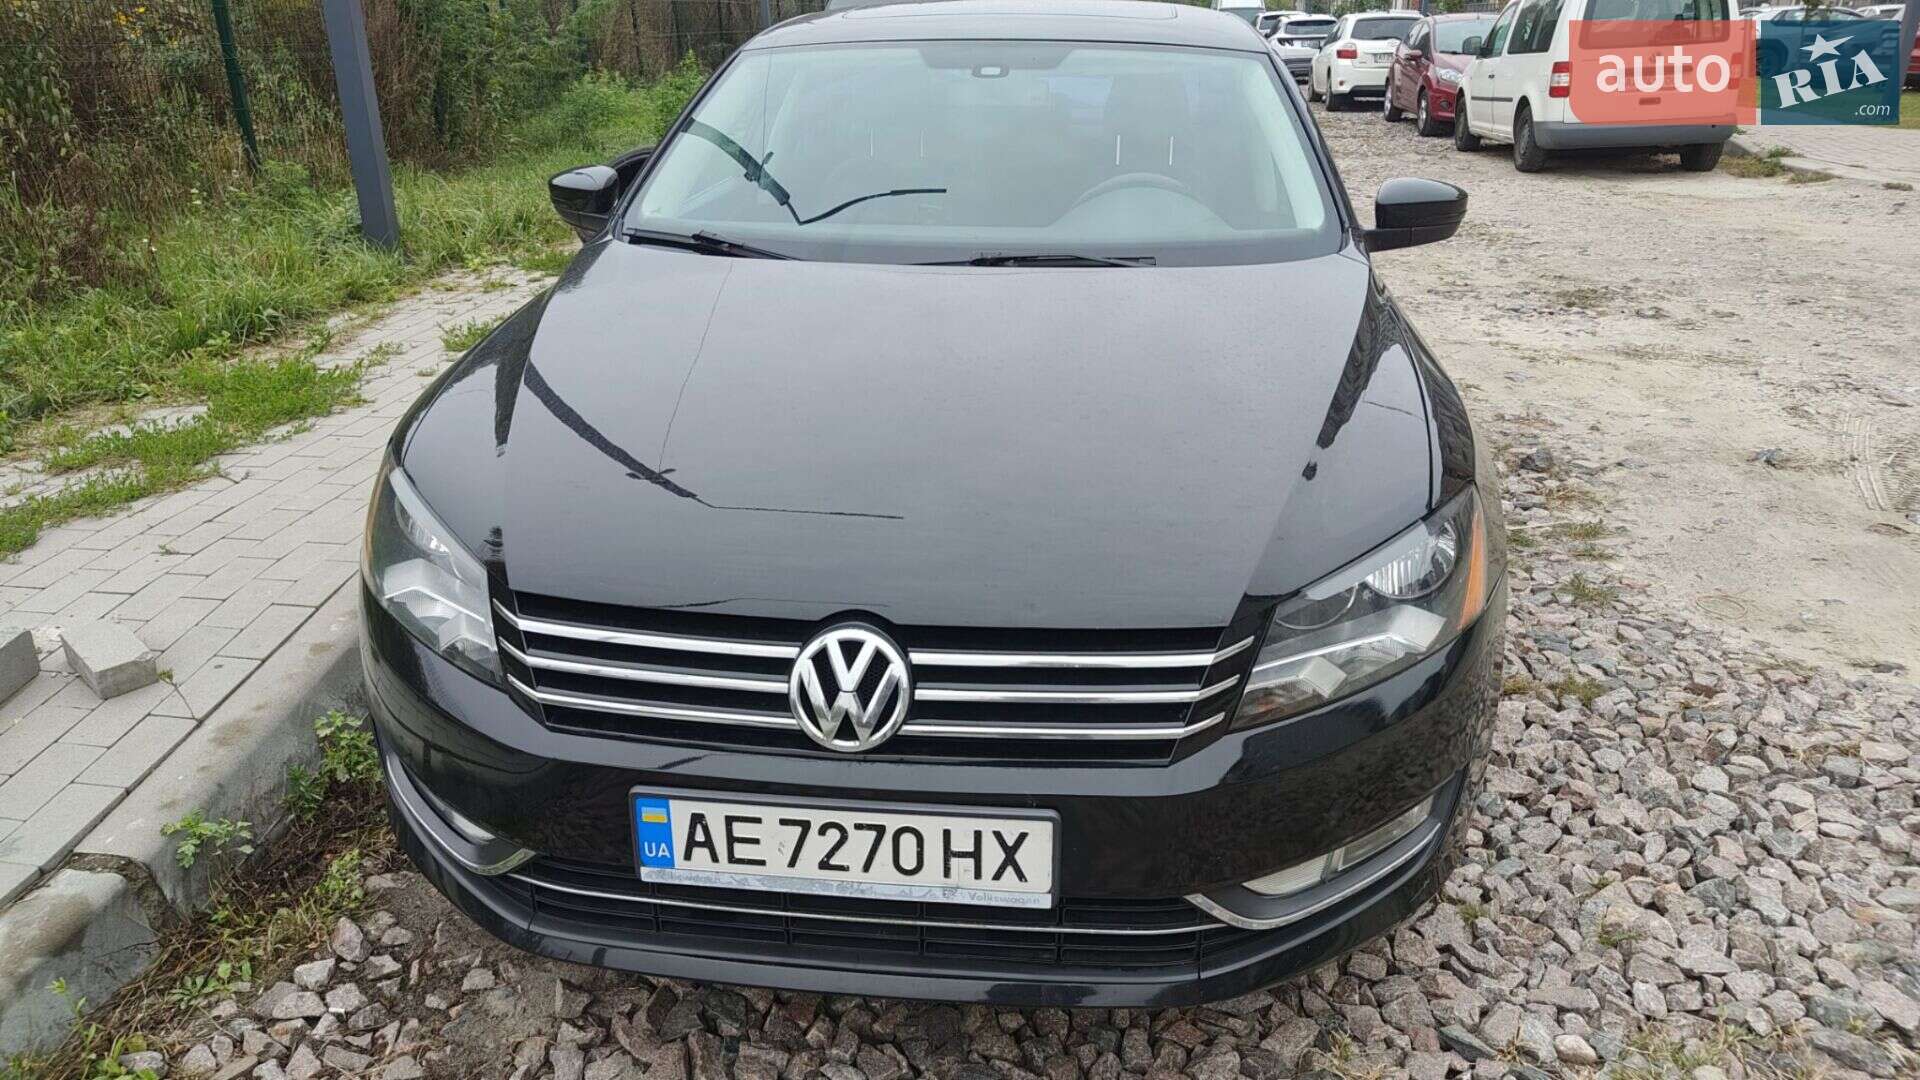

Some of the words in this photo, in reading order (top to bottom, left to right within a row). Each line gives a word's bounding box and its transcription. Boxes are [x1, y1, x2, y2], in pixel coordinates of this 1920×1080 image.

[644, 842, 671, 858] UA
[683, 812, 767, 866] AE
[778, 818, 925, 876] 7270
[942, 828, 1030, 883] HX
